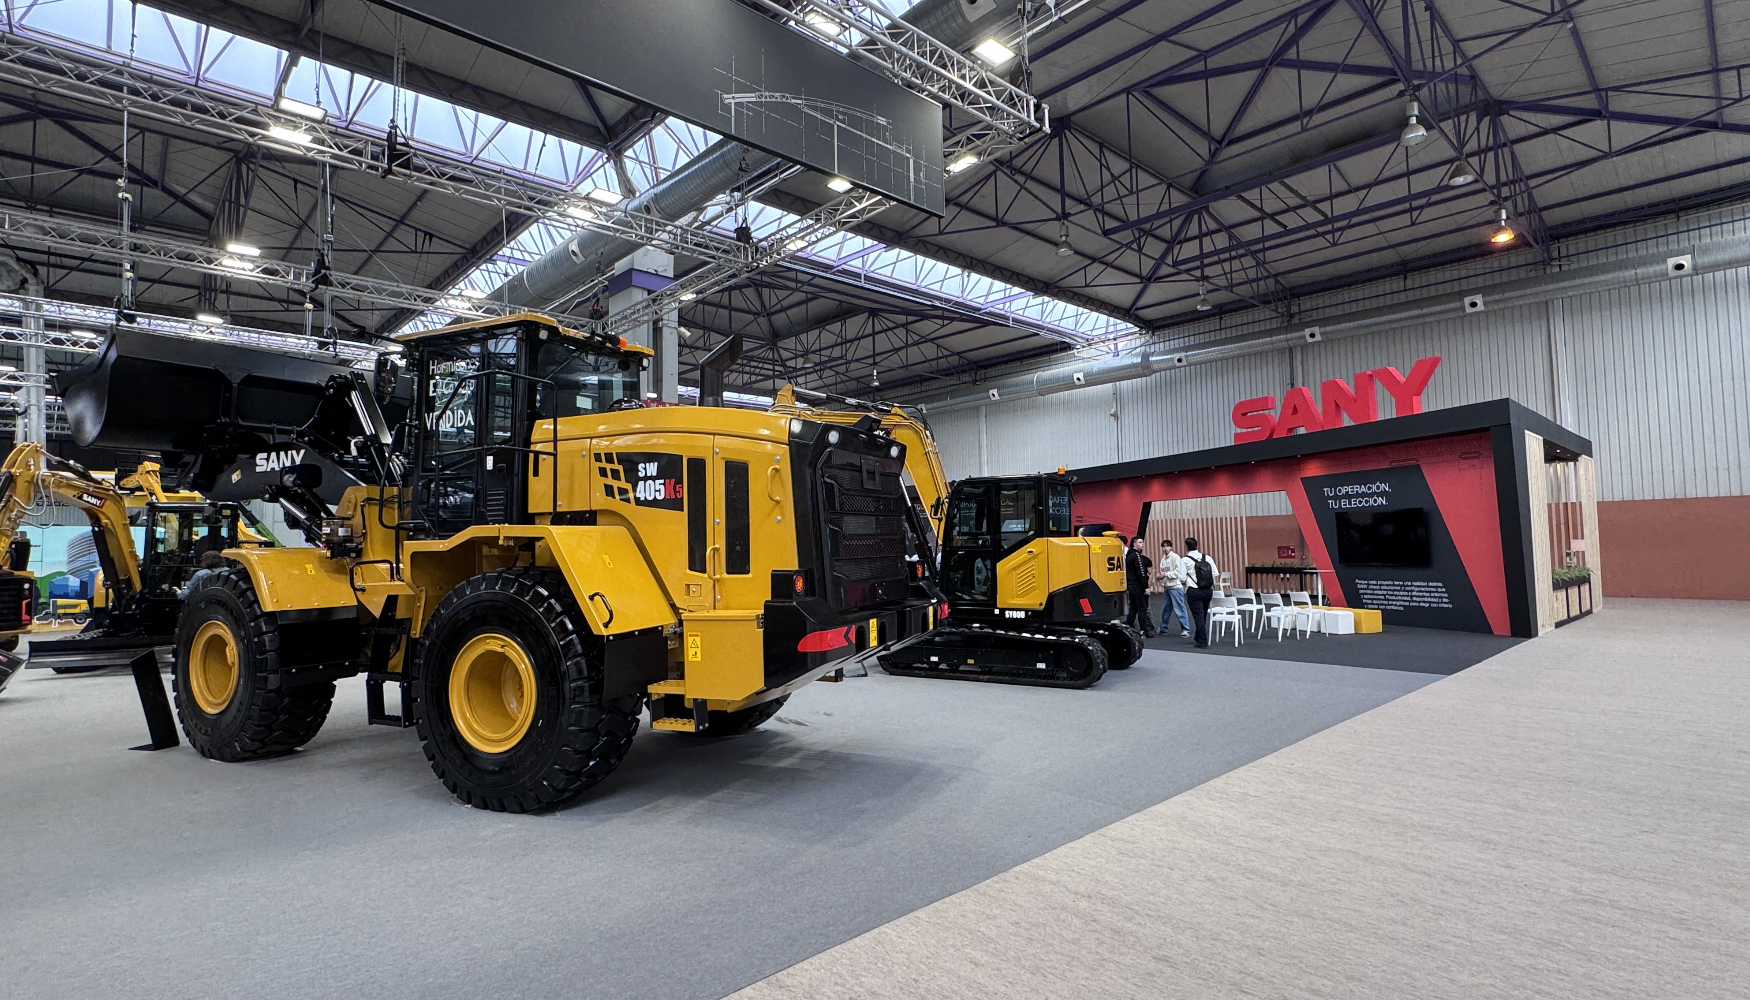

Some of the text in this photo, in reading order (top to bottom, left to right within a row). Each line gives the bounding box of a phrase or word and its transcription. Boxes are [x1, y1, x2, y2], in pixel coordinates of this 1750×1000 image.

[1232, 356, 1443, 445] SANY
[255, 449, 305, 472] SANY
[638, 462, 658, 477] SW
[1323, 481, 1392, 496] TU OPERACIÓN,
[82, 493, 101, 507] SANY
[1328, 495, 1389, 508] TU ELECCIÓN.
